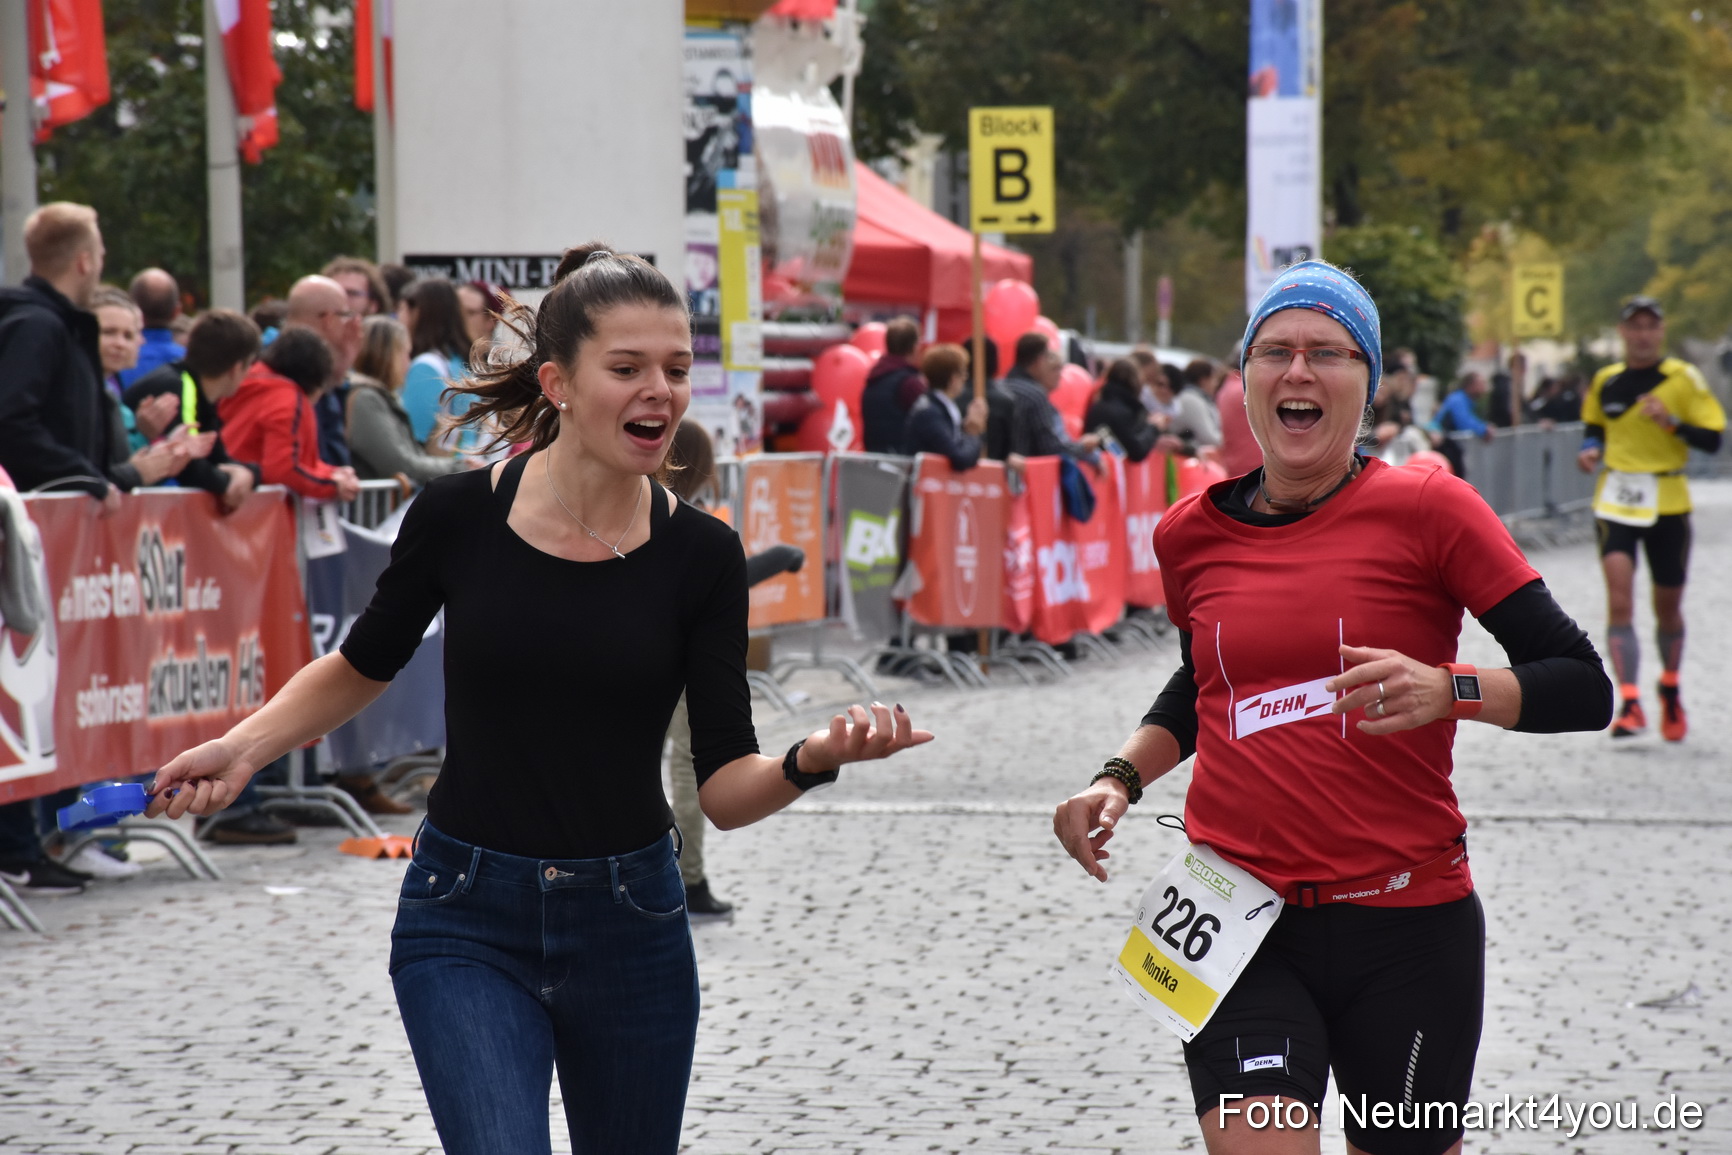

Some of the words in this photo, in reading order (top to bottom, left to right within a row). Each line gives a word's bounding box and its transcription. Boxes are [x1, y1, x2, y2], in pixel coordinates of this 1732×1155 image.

[980, 115, 1041, 136] Block
[994, 147, 1031, 204] B
[1524, 286, 1548, 320] C
[146, 631, 231, 719] aktuellen
[1259, 693, 1307, 719] DEHN
[1191, 858, 1237, 898] BOCK
[1332, 892, 1348, 901] new
[1349, 888, 1380, 899] balance
[1151, 885, 1221, 962] 226
[1141, 952, 1178, 993] Monika
[1254, 1059, 1274, 1067] DEHN
